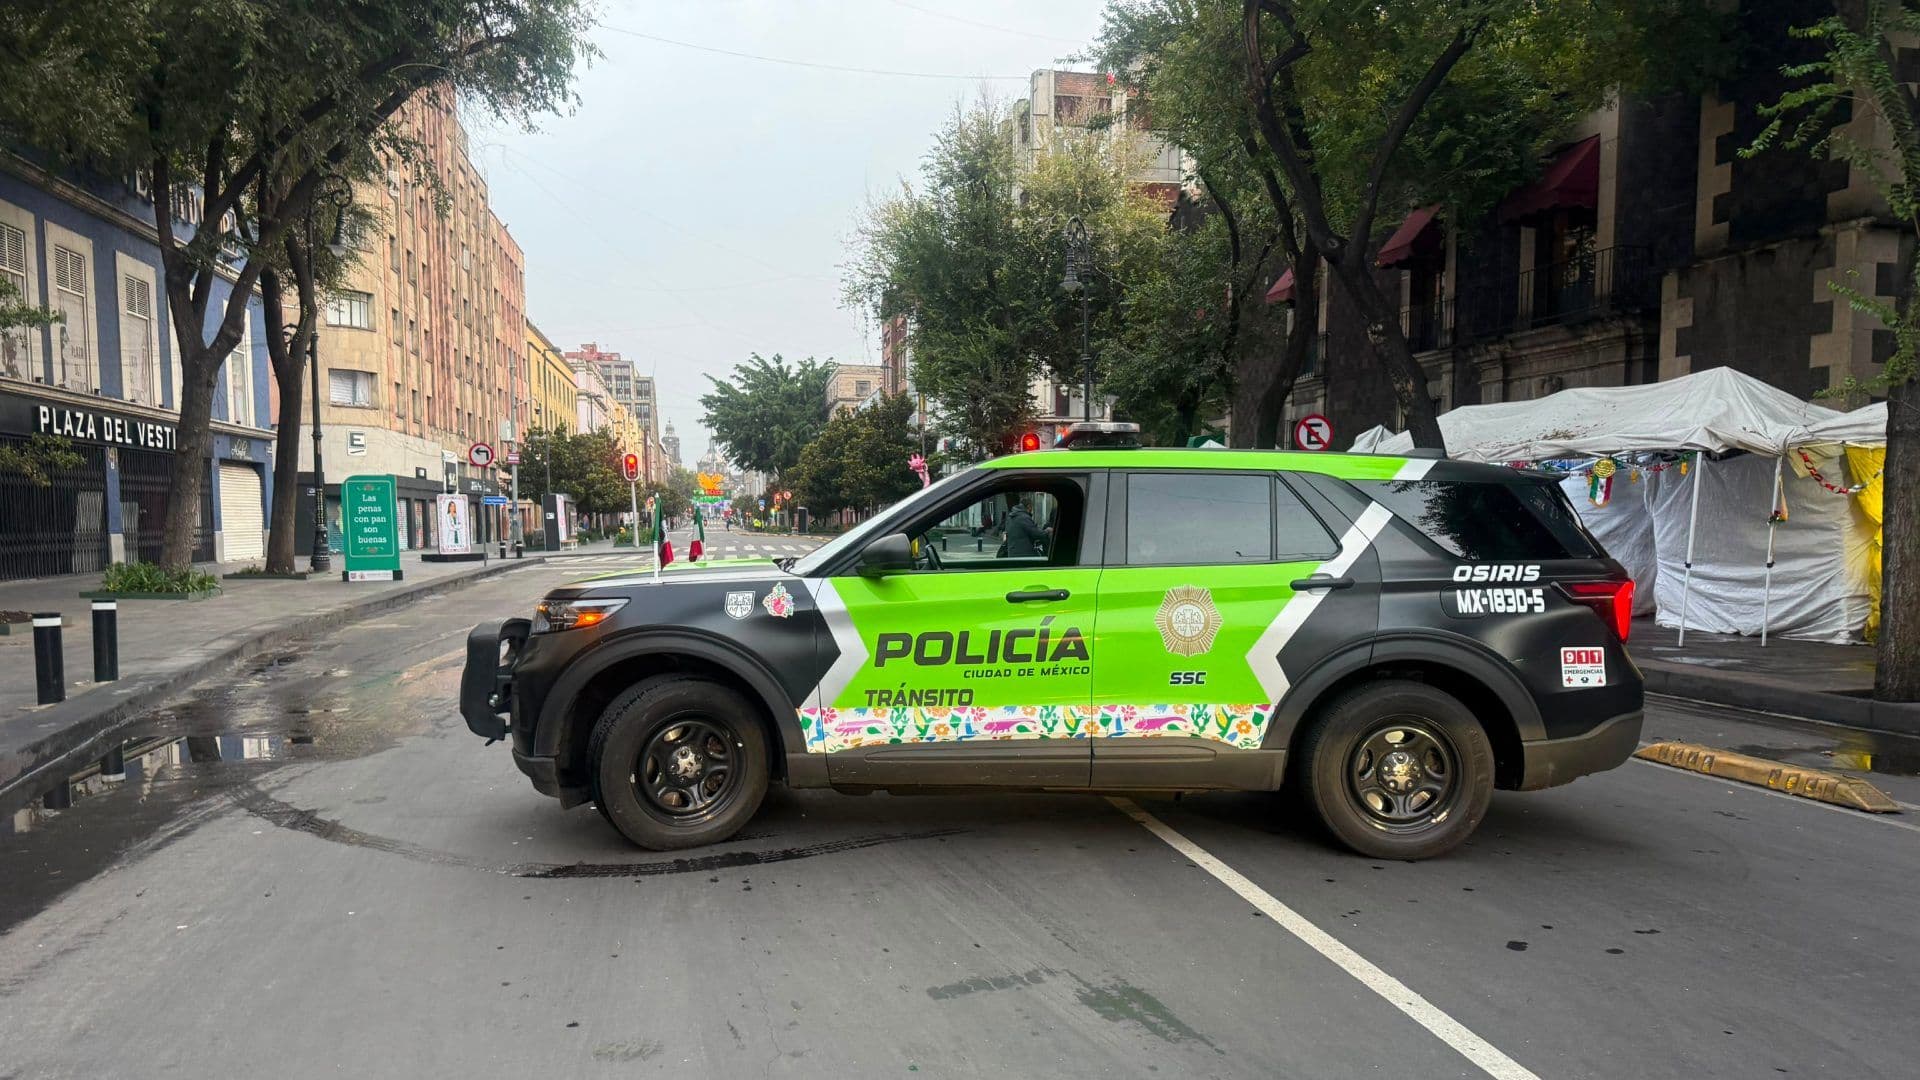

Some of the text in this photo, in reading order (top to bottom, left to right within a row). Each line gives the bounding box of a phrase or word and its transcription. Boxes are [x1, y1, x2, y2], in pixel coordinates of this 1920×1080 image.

[39, 405, 97, 440] PLAZA
[103, 416, 133, 445] DEL
[350, 432, 364, 447] E
[362, 494, 376, 502] Las
[358, 505, 381, 514] penas
[371, 516, 386, 525] pan
[358, 535, 387, 543] buenas
[1453, 565, 1541, 581] OSIRIS
[874, 615, 1090, 668] POLICÍA
[1564, 651, 1600, 663] 911
[963, 664, 1090, 679] CIUDAD DE MÉXICO
[1169, 671, 1207, 685] SSC
[864, 682, 974, 707] TRÁNSITO
